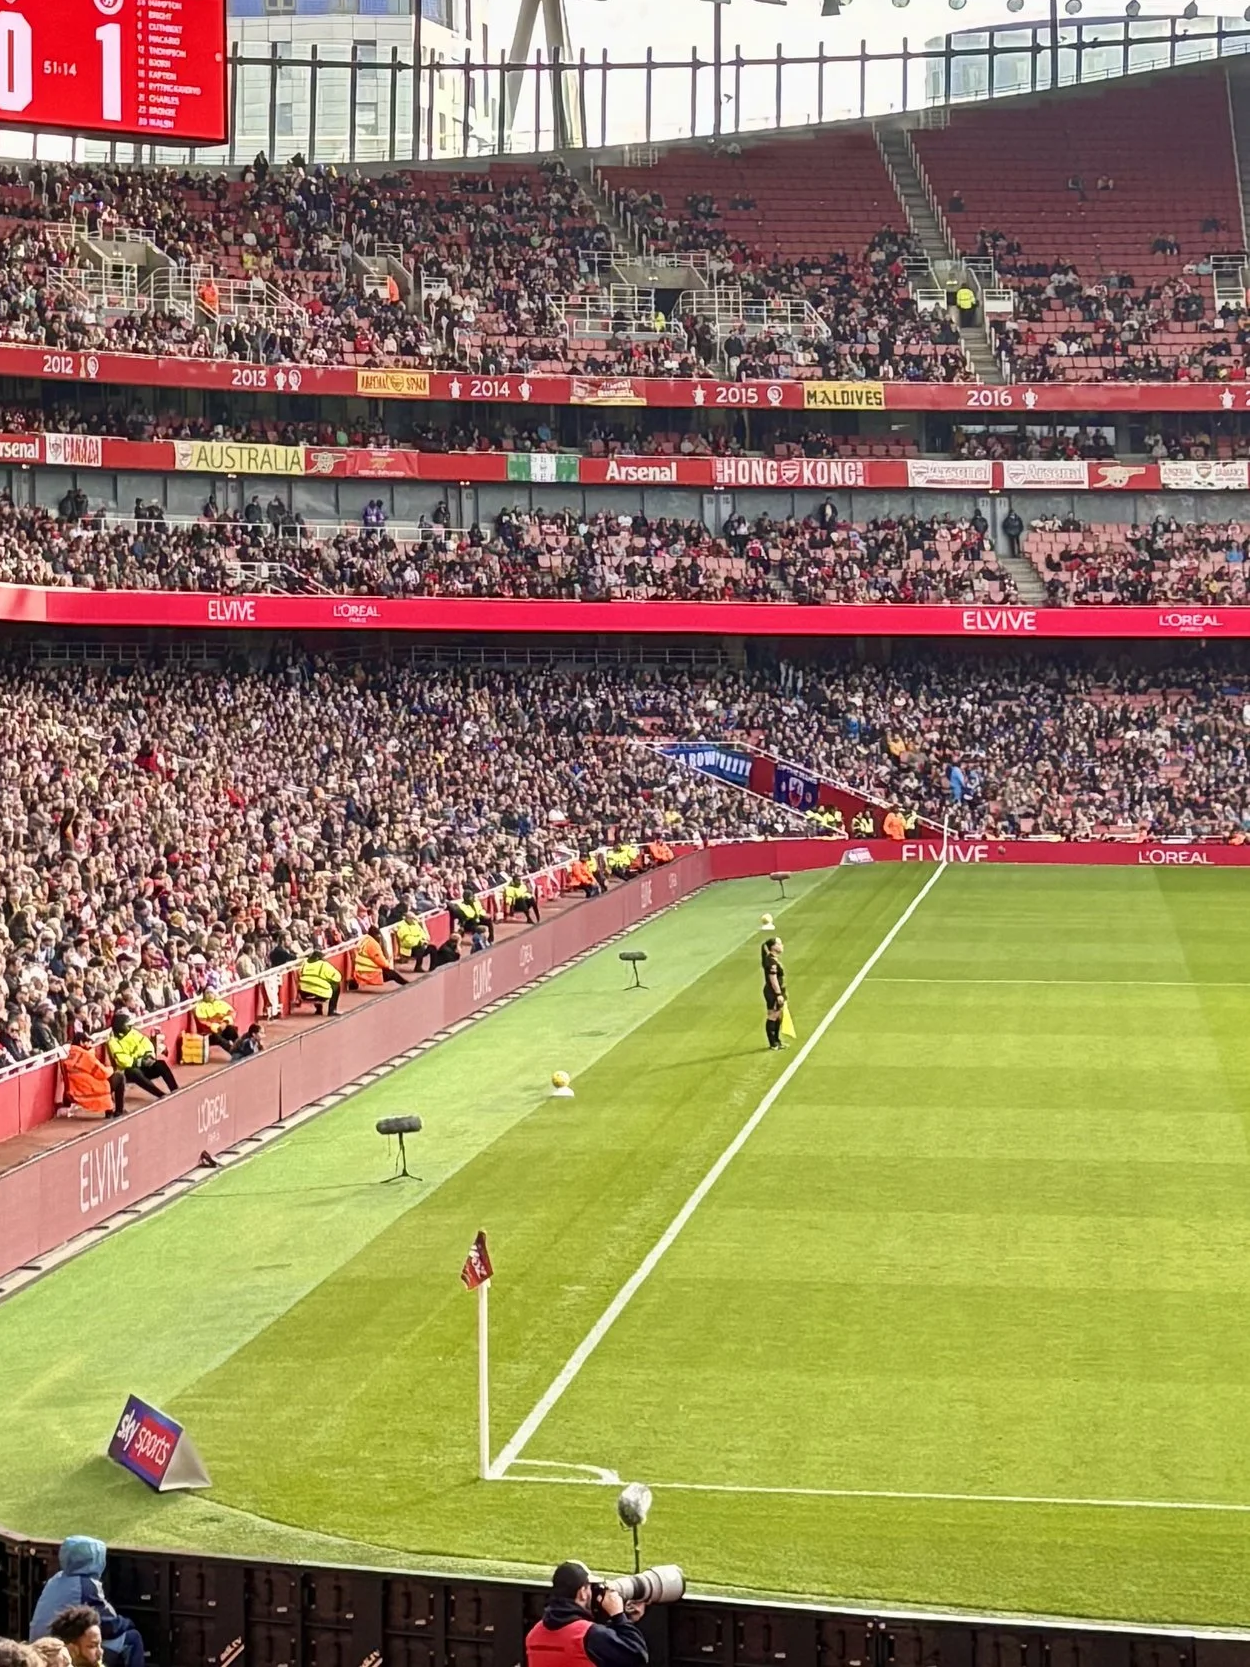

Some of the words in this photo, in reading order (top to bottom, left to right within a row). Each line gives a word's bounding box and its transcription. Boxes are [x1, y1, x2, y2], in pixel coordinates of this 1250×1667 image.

[43, 60, 77, 77] 51:14
[96, 22, 122, 122] 1
[43, 355, 73, 374] 2012
[231, 368, 267, 386] 2013
[470, 380, 510, 398] 2014
[715, 387, 758, 404] 2015
[806, 390, 883, 407] MALDIVES
[966, 390, 1013, 407] 2016
[63, 437, 100, 464] CANADA
[196, 444, 303, 472] AUSTRALIA
[606, 460, 677, 481] Arsenal
[724, 460, 778, 484] HONG
[803, 461, 856, 485] KONG
[1027, 463, 1084, 480] Arsenal
[208, 600, 255, 622] ELVIVE
[962, 611, 1037, 631] ELVIVE
[80, 1133, 130, 1214] ELVIVE
[117, 1409, 141, 1451] sky
[135, 1426, 171, 1466] sports
